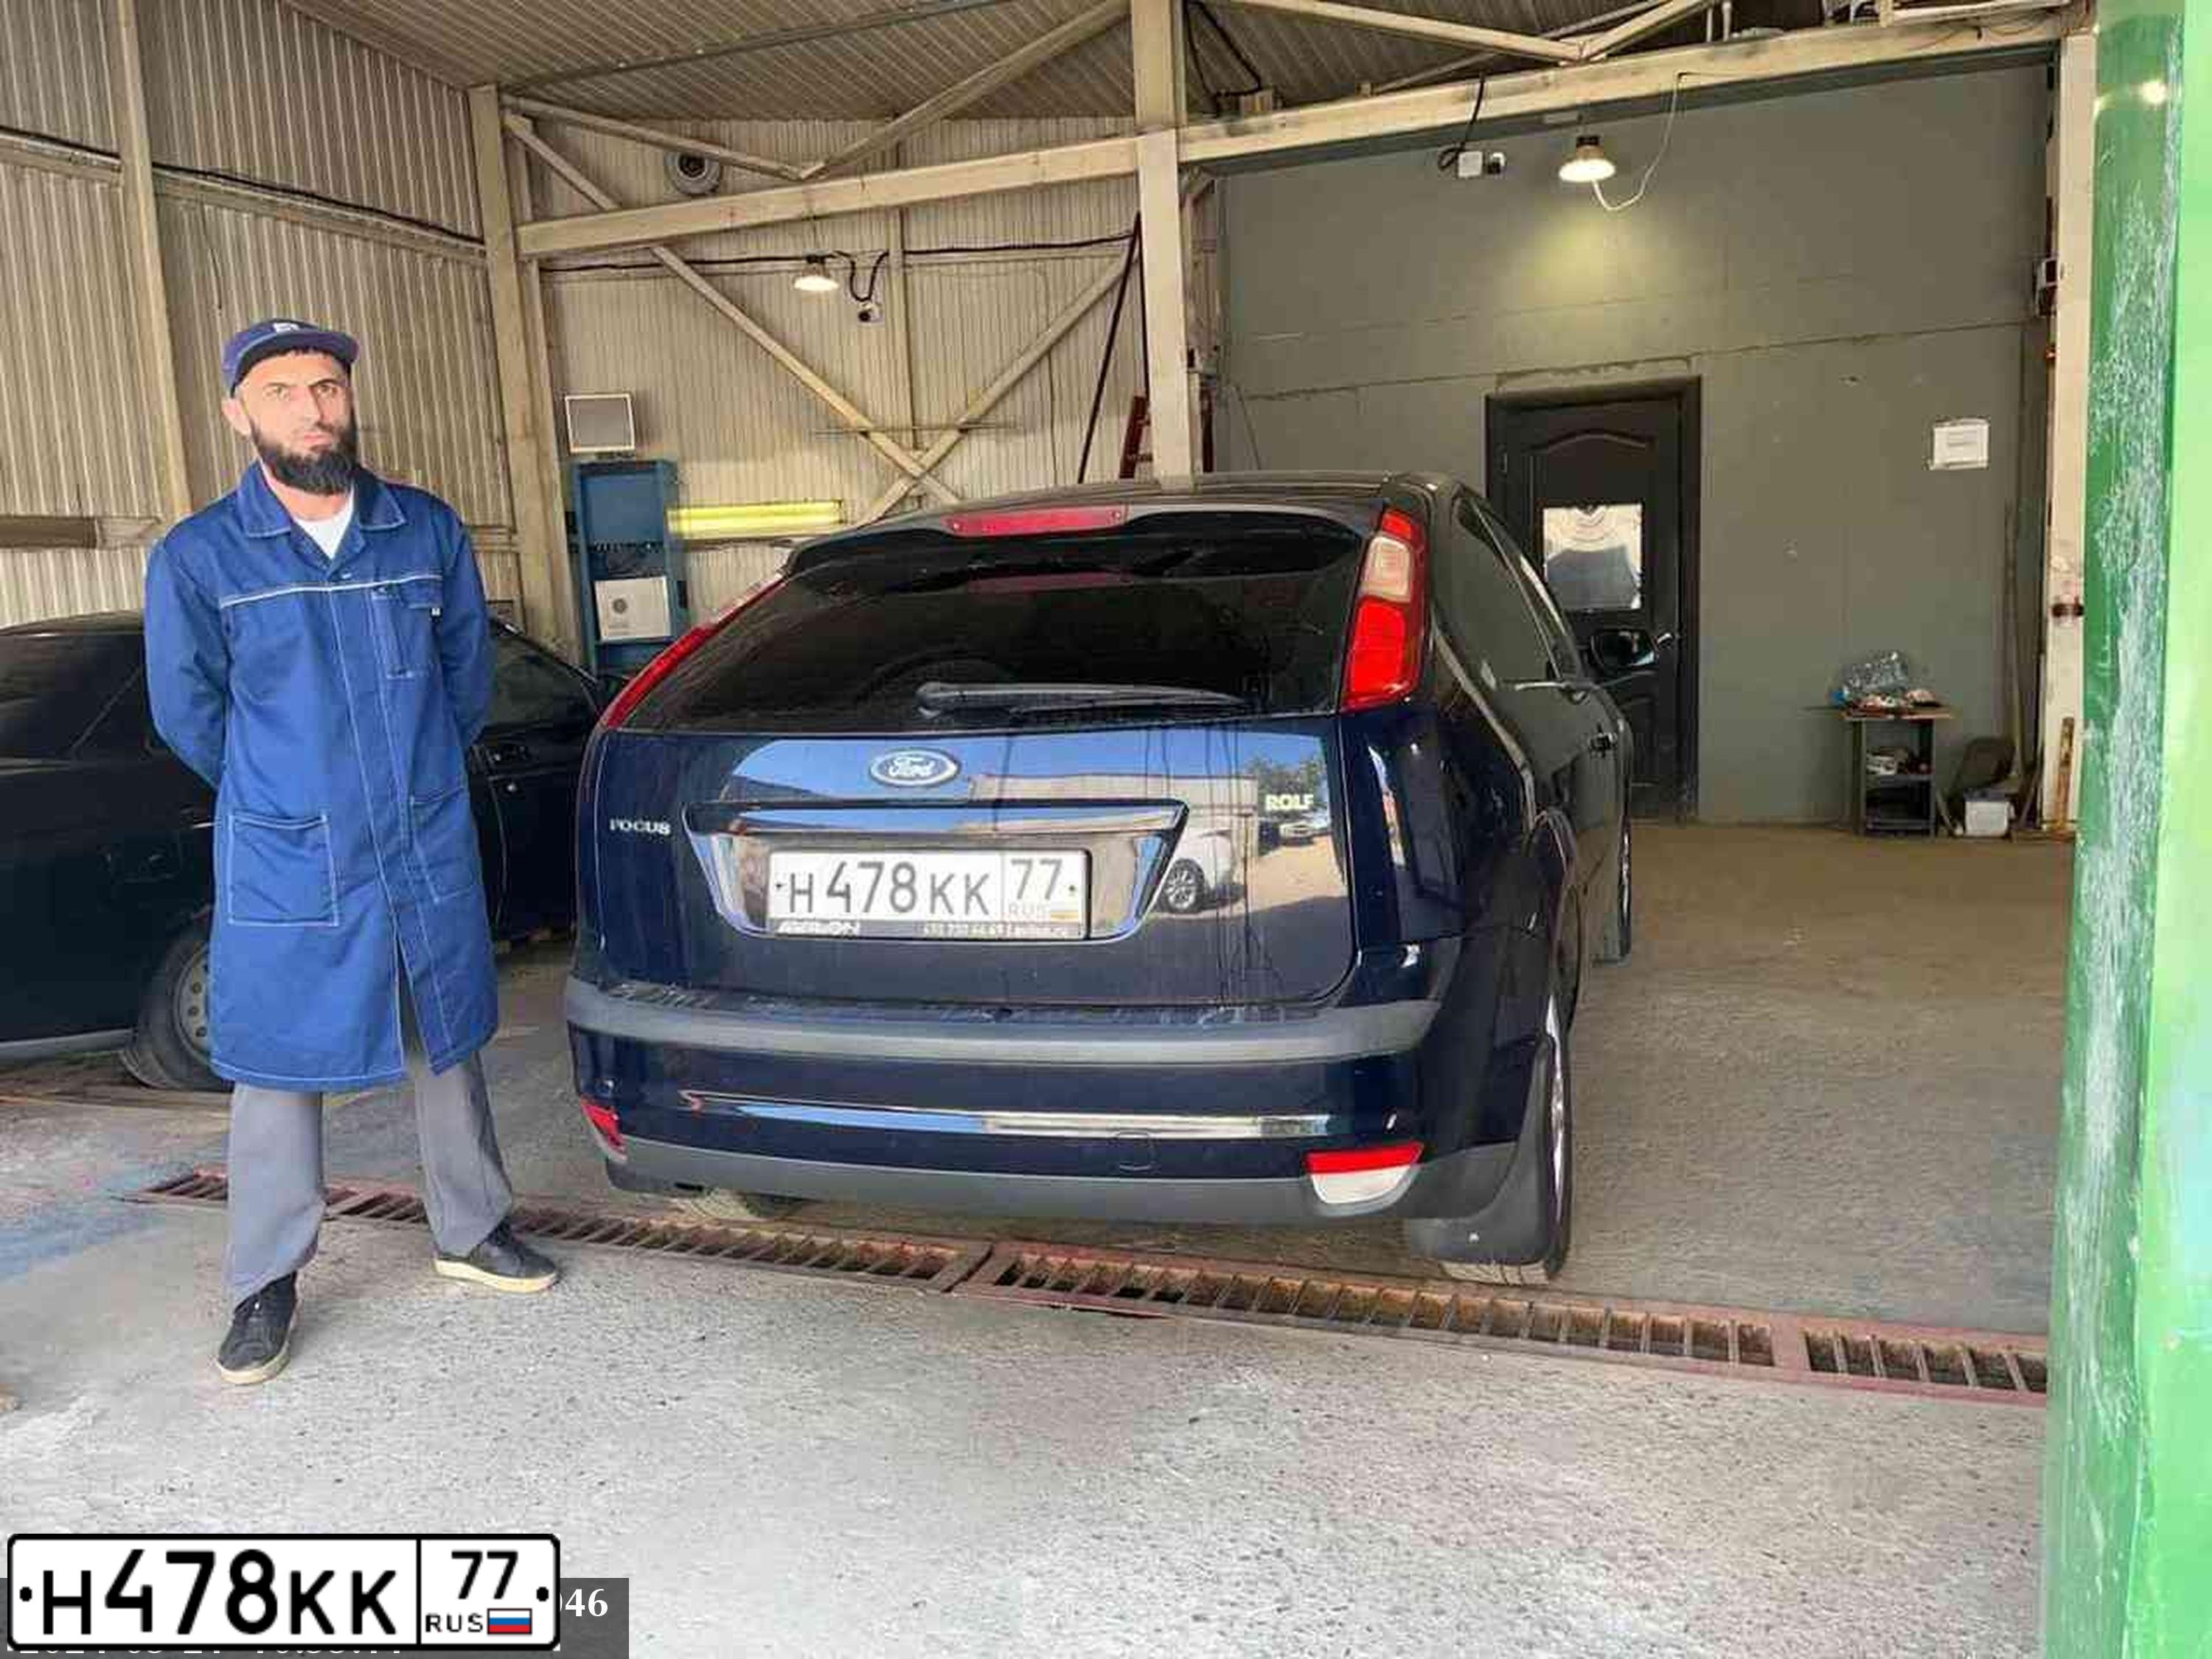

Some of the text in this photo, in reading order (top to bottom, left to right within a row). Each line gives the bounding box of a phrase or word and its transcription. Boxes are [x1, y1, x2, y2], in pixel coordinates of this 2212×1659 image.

[888, 756, 936, 777] Ford
[1265, 793, 1314, 811] ROLF
[609, 818, 670, 835] FOCUS
[789, 859, 1062, 915] Н478КК 77
